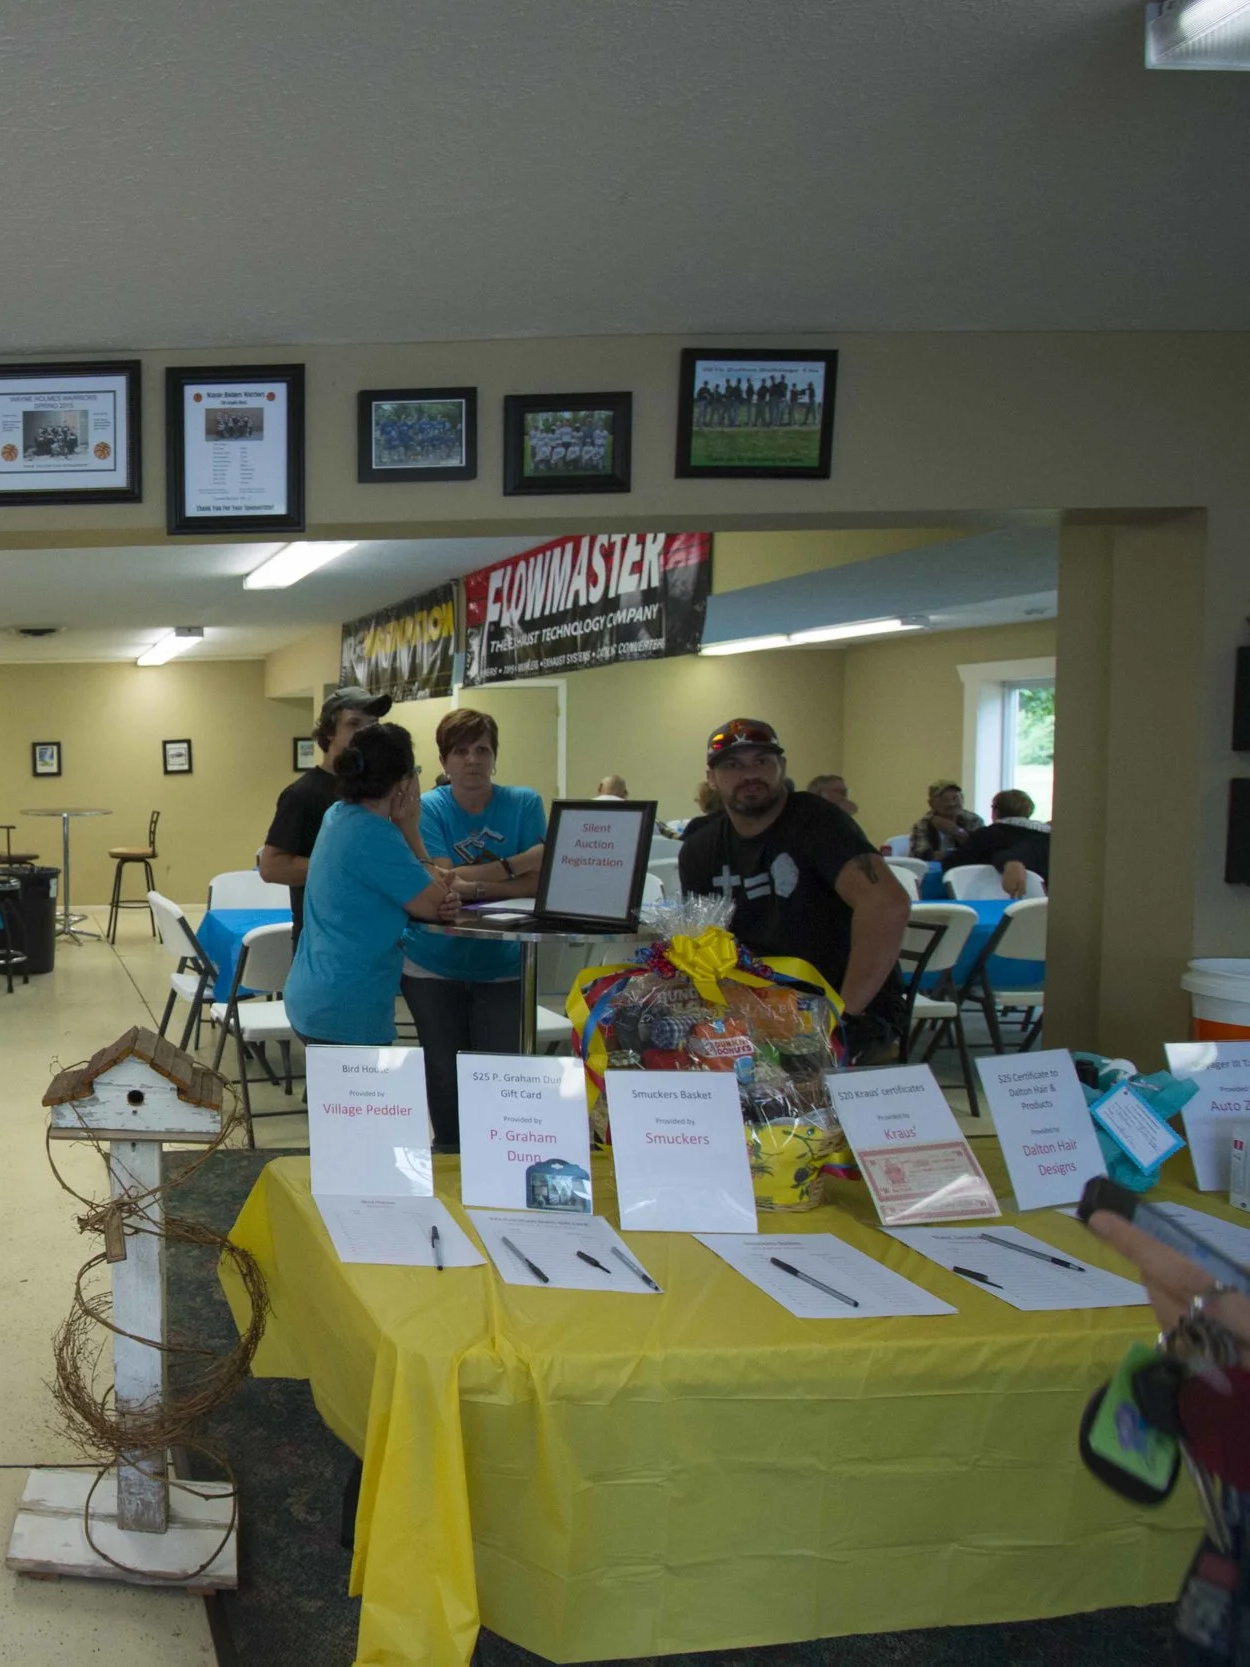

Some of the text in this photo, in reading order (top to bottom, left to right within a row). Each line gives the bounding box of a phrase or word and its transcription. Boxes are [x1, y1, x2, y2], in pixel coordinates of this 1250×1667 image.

[486, 534, 666, 628] FLOWMASTER
[489, 640, 508, 653] THE
[541, 615, 606, 643] TECHNOLOGY
[582, 823, 611, 833] Silent
[574, 839, 615, 850] Auction
[561, 855, 624, 868] Registration
[717, 1045, 752, 1055] DONUTS
[342, 1064, 389, 1074] Bird Houe
[472, 1071, 564, 1085] $25 P. Graham Dun
[998, 1070, 1059, 1084] $25 Certificate to
[349, 1089, 385, 1098] Provided by
[500, 1089, 543, 1099] Gift Card
[631, 1089, 712, 1100] Smuckers Basket
[855, 1087, 880, 1099] Kraus'
[880, 1084, 926, 1096] certificates
[1008, 1087, 1033, 1097] Dalton
[1033, 1084, 1048, 1094] Hair
[322, 1103, 413, 1118] Village Peddler
[1022, 1100, 1054, 1110] Products
[1210, 1100, 1241, 1112] Auto
[503, 1115, 543, 1126] Provided by
[655, 1117, 685, 1125] Provided
[490, 1129, 557, 1144] P. Graham
[645, 1132, 711, 1146] Smuckers
[883, 1126, 918, 1140] Kraus'
[1022, 1140, 1078, 1157] Dalton Hair
[507, 1150, 542, 1162] Dunn
[1037, 1162, 1077, 1177] Designs
